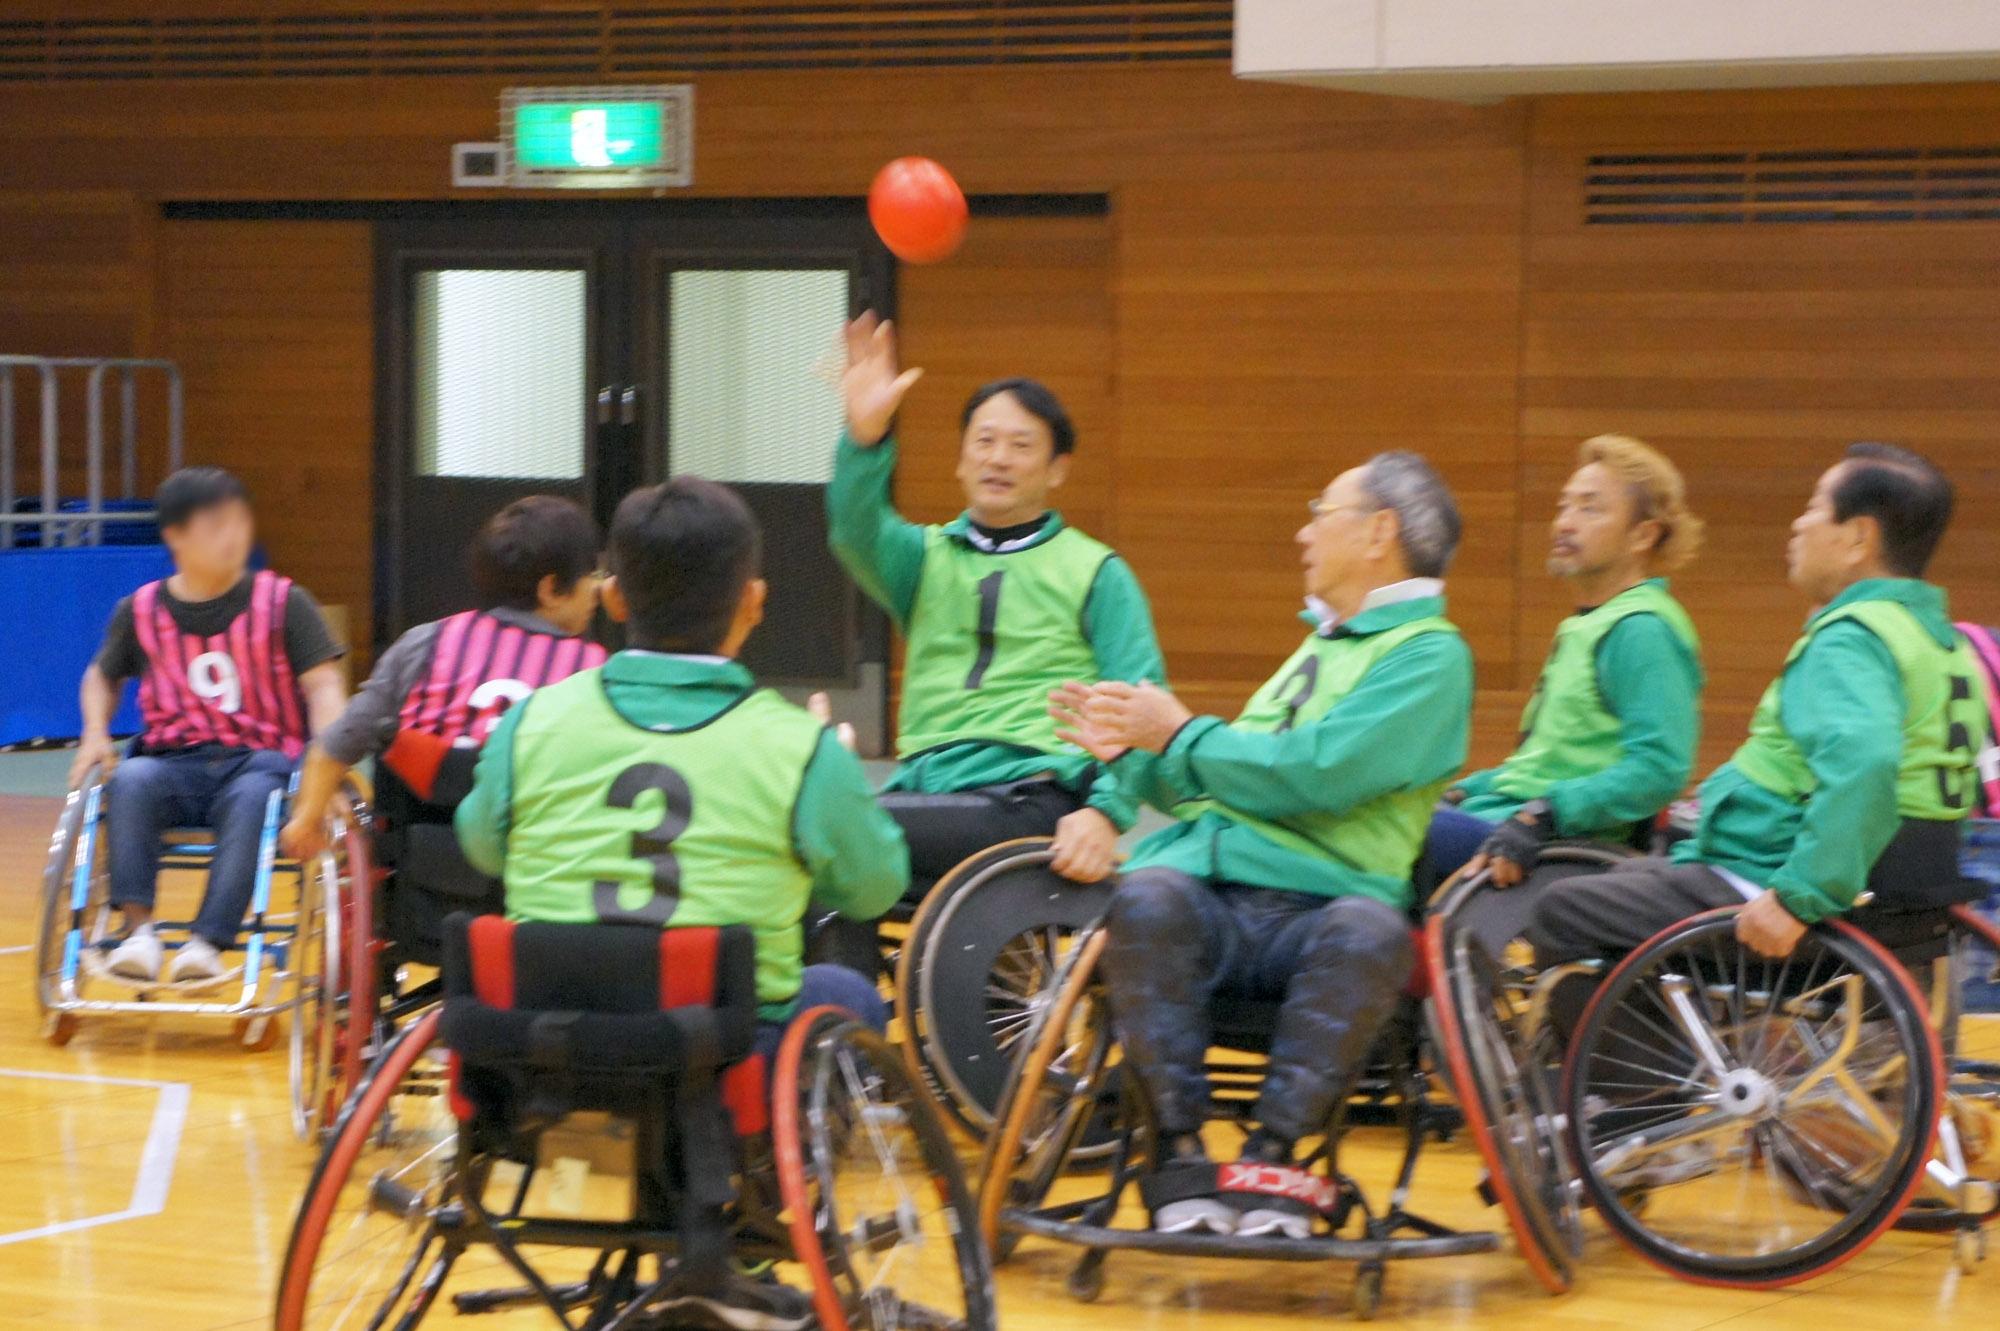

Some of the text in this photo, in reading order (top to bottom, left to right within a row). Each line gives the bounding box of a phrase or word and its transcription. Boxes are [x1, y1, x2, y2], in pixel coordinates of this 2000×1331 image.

[189, 651, 242, 713] 9
[965, 570, 1004, 690] 1
[592, 762, 693, 928] 3
